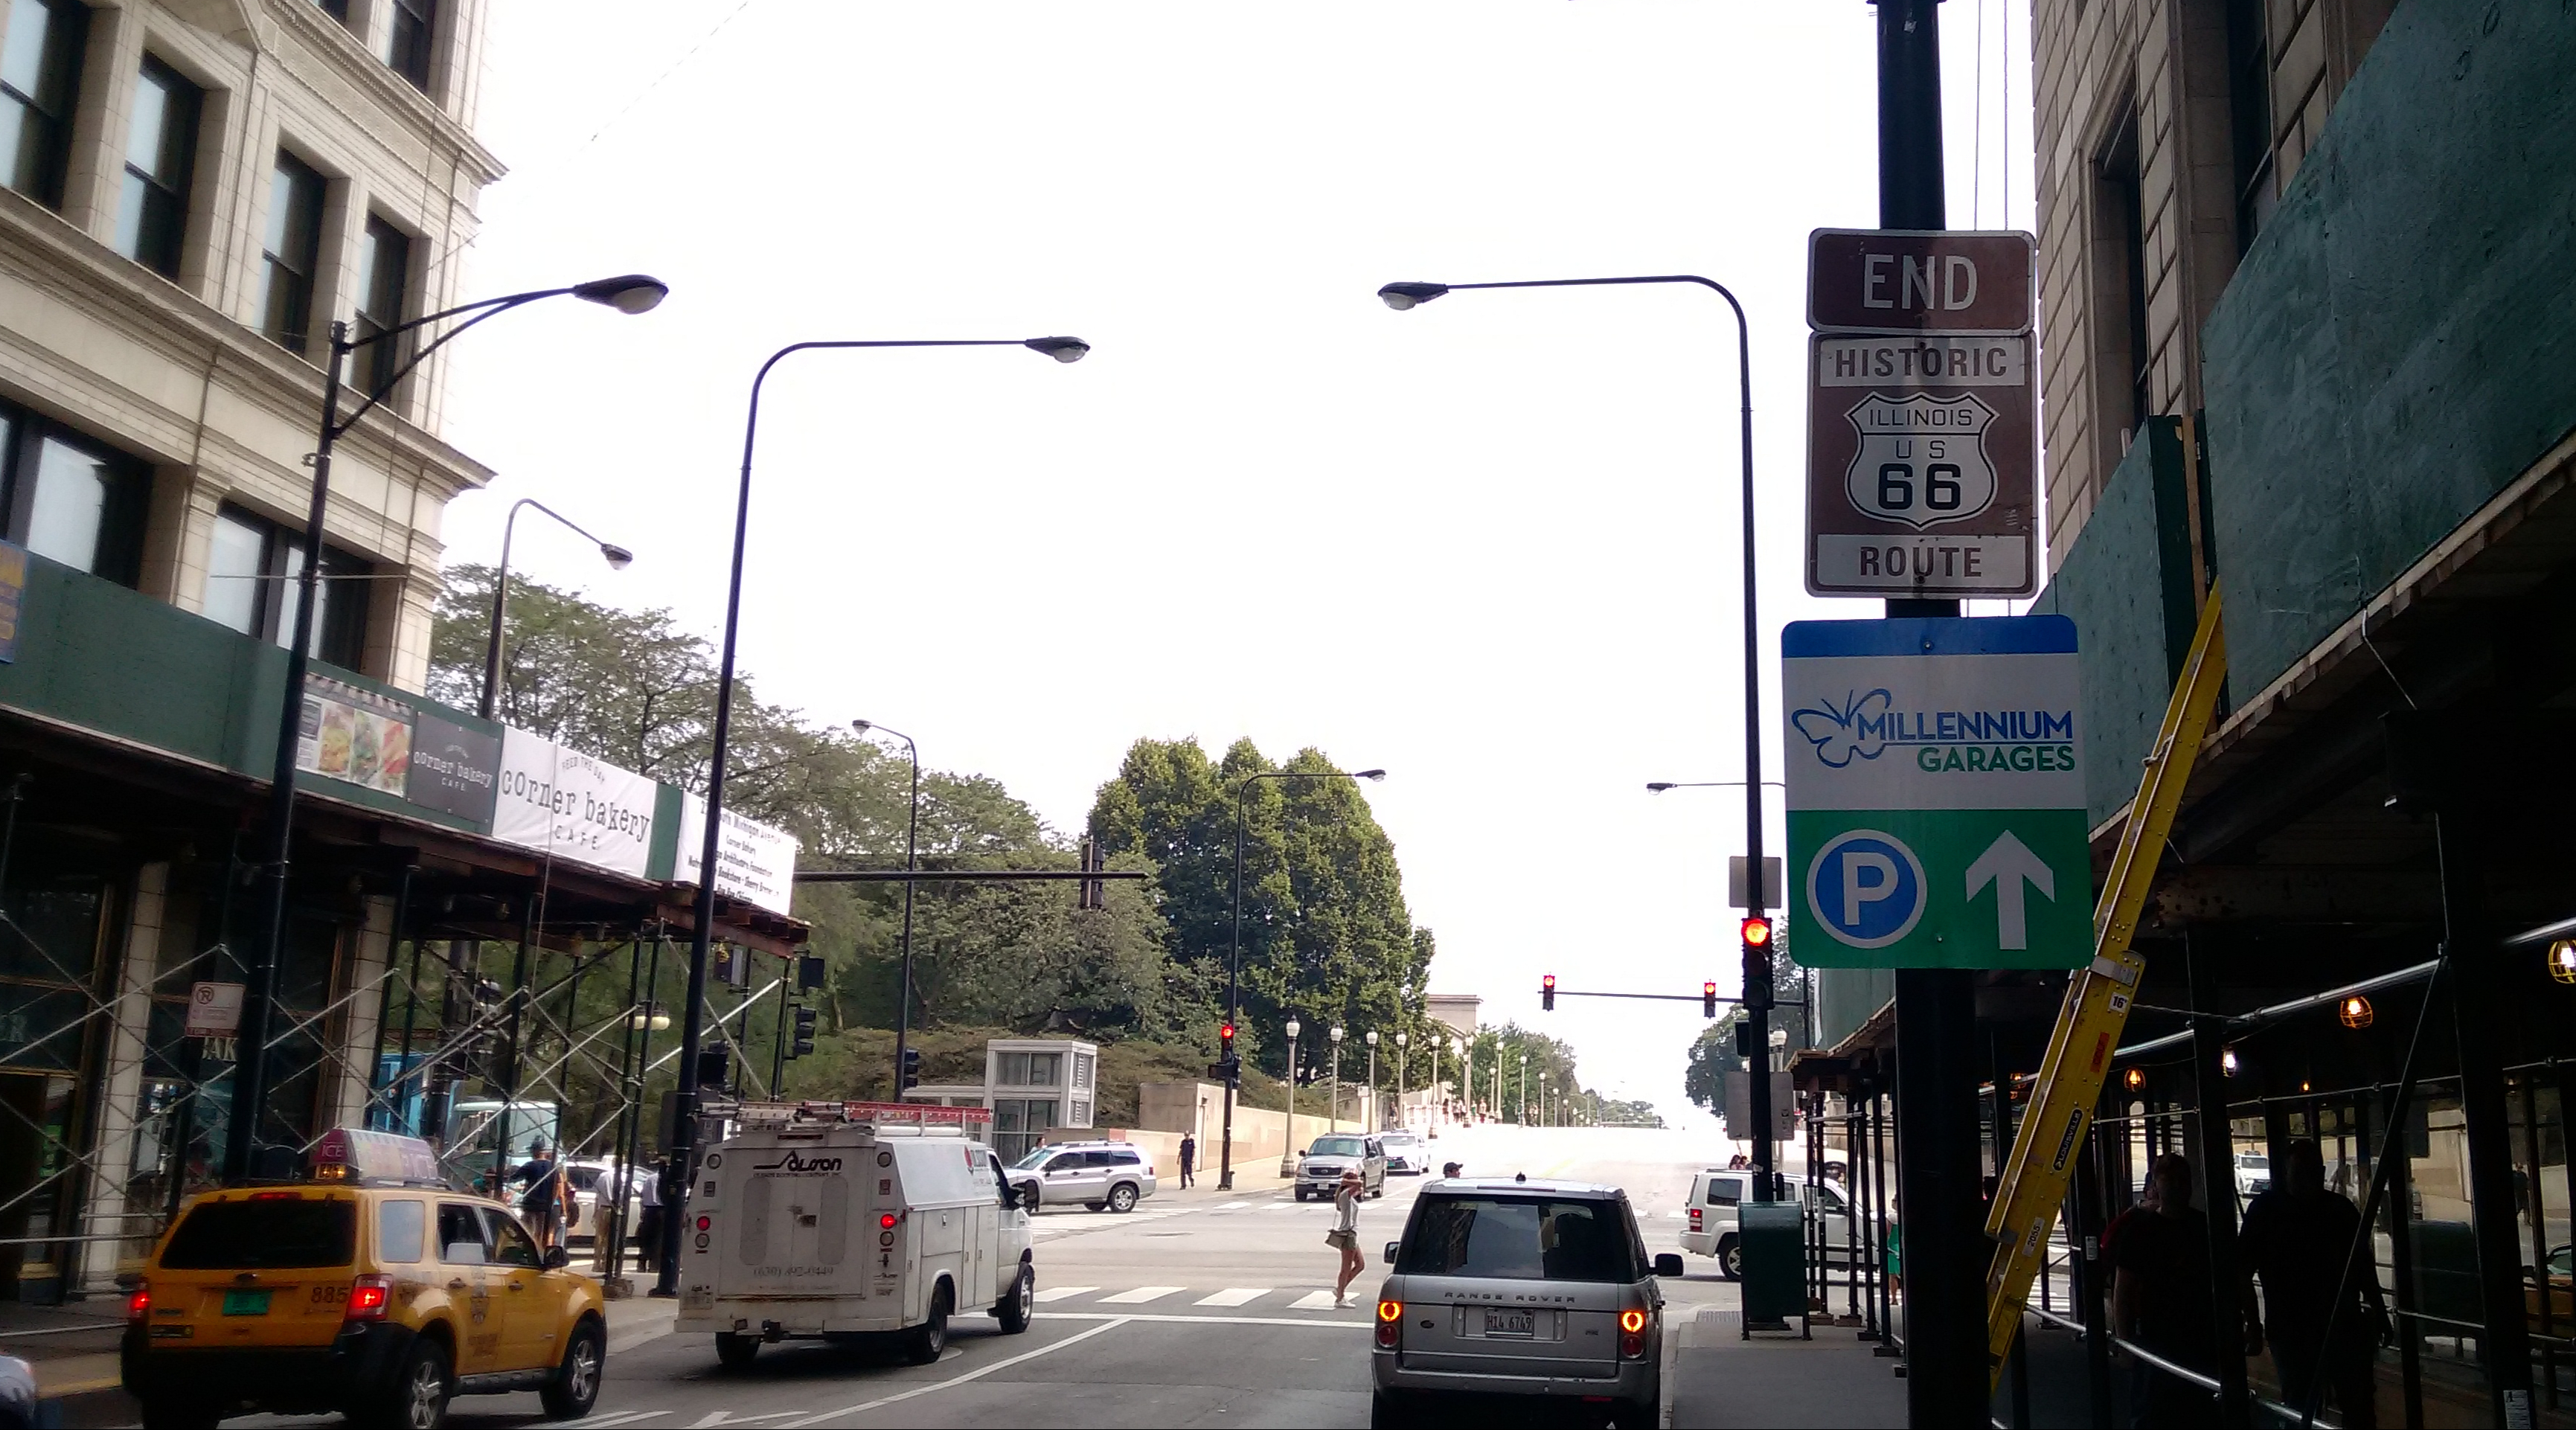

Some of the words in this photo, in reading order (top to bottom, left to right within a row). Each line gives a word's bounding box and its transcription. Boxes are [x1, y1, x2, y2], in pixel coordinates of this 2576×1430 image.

[1862, 254, 1978, 311] END
[1835, 347, 2008, 378] HISTORIC
[1869, 408, 1973, 426] ILLINOIS
[1877, 463, 1961, 510] 66
[1859, 545, 1982, 578] ROUTE
[1857, 710, 2074, 742] MILLENNIUM
[413, 751, 455, 775] corner
[457, 761, 493, 789] bakery
[1917, 746, 2076, 773] GARAGES
[502, 769, 577, 816] corner
[585, 791, 650, 843] bakery
[2060, 1112, 2081, 1161] LOUISVILLE
[2026, 1225, 2041, 1248] 2055
[310, 1286, 350, 1304] 885
[1444, 1292, 1504, 1301] RANGE
[1515, 1294, 1576, 1303] ROVER
[1508, 1316, 1533, 1330] 6749
